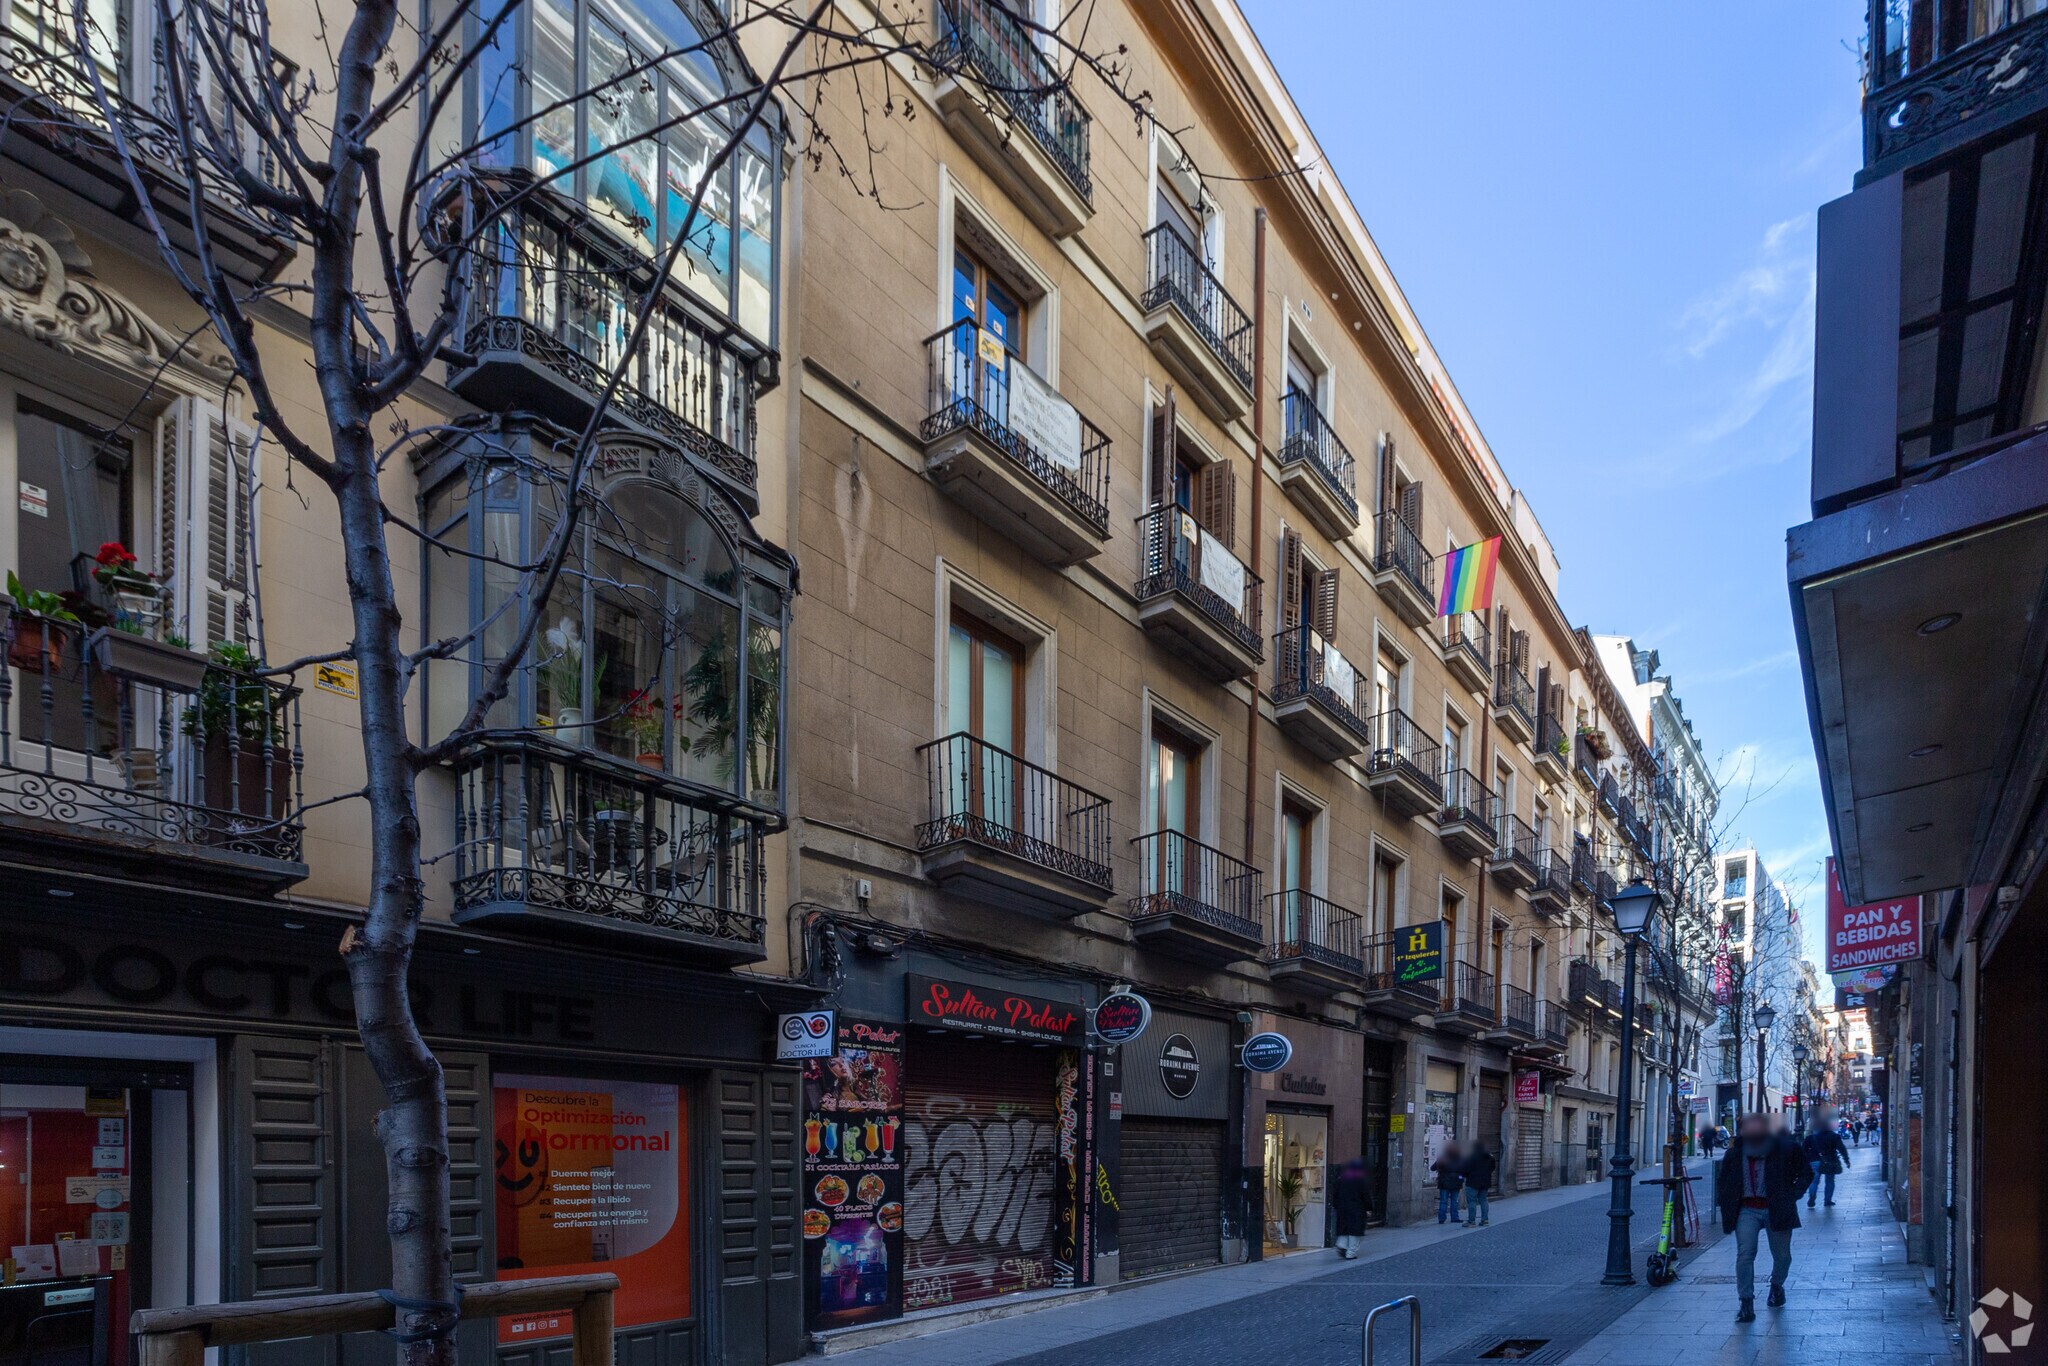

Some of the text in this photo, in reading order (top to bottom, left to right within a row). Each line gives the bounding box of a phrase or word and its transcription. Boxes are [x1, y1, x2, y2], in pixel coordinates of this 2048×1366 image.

[318, 681, 355, 695] PROSEGUR
[1844, 904, 1903, 929] PAN Y
[1836, 919, 1912, 947] BEBIDAS
[1405, 950, 1440, 960] Izquierda
[1831, 941, 1917, 968] SANDWICHES
[460, 984, 594, 1040] LIFE
[922, 983, 1078, 1033] Sultan Palast
[1098, 1004, 1140, 1020] Sultan
[852, 1023, 901, 1044] Palast
[942, 1018, 1063, 1042] RESTAURANT CAFE BAR SHISHA LOUNGE
[780, 1048, 830, 1058] DOCTOR LIFE
[1182, 1062, 1200, 1071] AVENUE
[525, 1093, 599, 1107] Descubre la
[524, 1108, 646, 1126] Optimización
[525, 1128, 669, 1151] Hormonal
[551, 1170, 588, 1178] Duerme
[590, 1169, 616, 1179] mejor
[553, 1183, 590, 1192] Sientete
[592, 1183, 611, 1191] bien
[553, 1197, 597, 1206] Recupera
[598, 1196, 606, 1204] la
[607, 1195, 631, 1204] libido
[554, 1211, 597, 1220] Recupera
[610, 1208, 641, 1219] energía
[553, 1219, 597, 1229] confianza
[612, 1218, 619, 1226] ti
